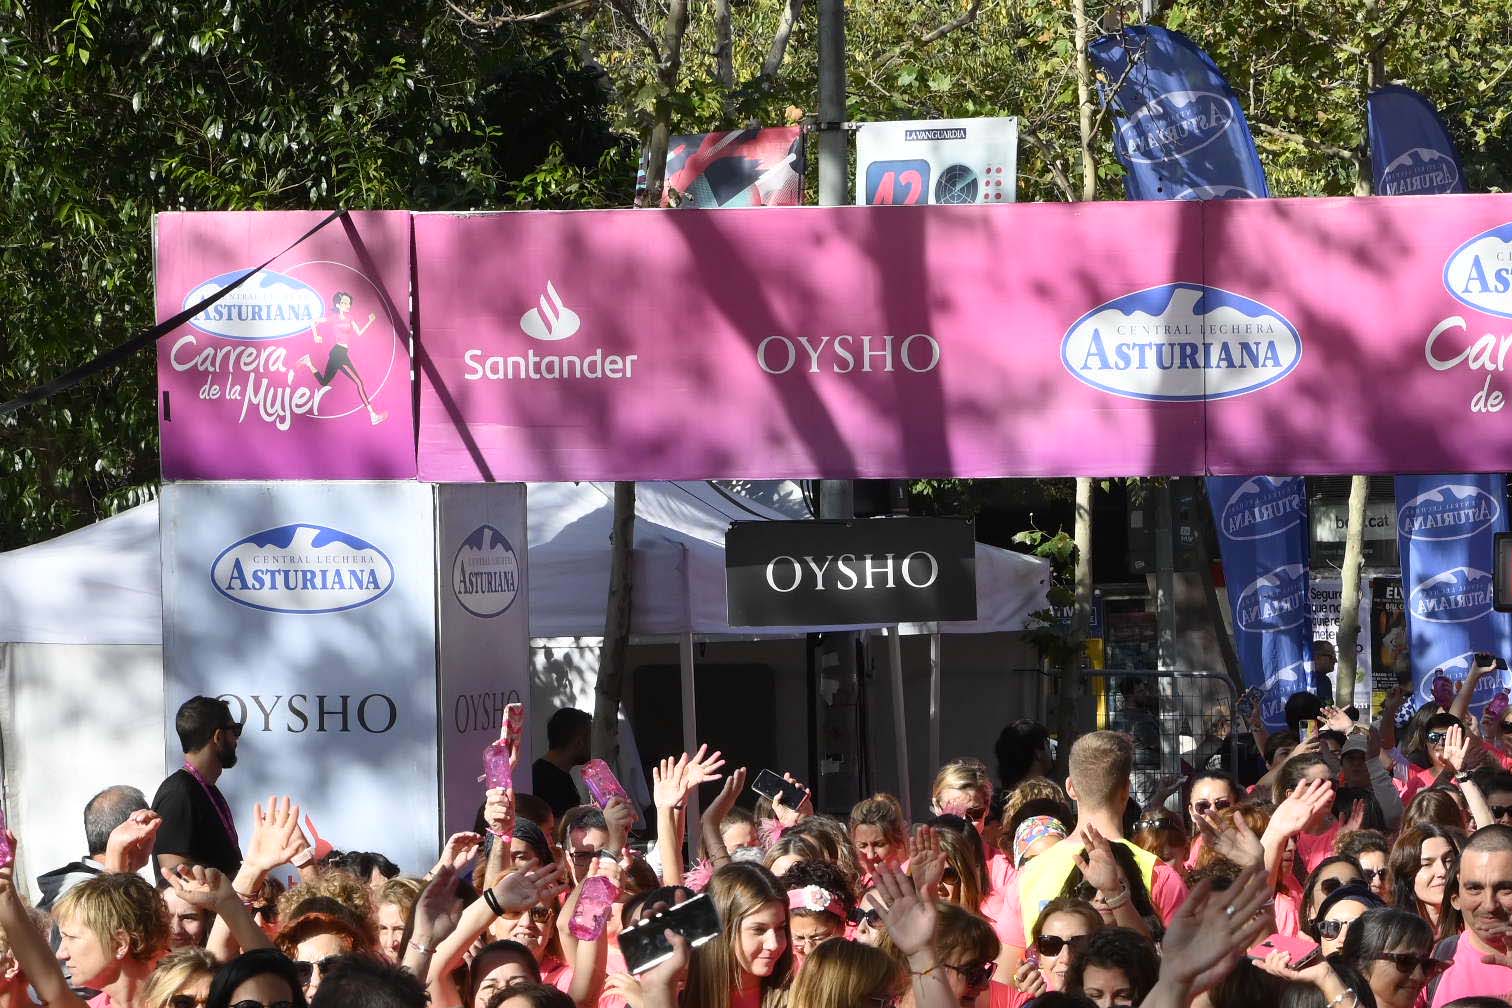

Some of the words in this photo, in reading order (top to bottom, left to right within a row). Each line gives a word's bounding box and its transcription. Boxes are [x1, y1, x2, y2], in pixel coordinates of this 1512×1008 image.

[193, 295, 314, 322] ASTURIANA
[1116, 325, 1192, 336] CENTRAL
[1199, 323, 1275, 335] LECHERA
[170, 335, 288, 372] Carrera
[464, 348, 638, 380] Santander
[756, 333, 940, 375] OYSHO
[1080, 327, 1284, 371] ASTURIANA
[199, 374, 221, 400] de
[225, 372, 241, 400] la
[238, 369, 333, 431] Mujer
[1470, 374, 1505, 414] de
[225, 557, 382, 591] ASTURIANA
[253, 555, 311, 564] CENTRAL
[317, 555, 375, 564] LECHERA
[457, 560, 516, 595] ASTURIANA
[766, 551, 939, 593] OYSHO
